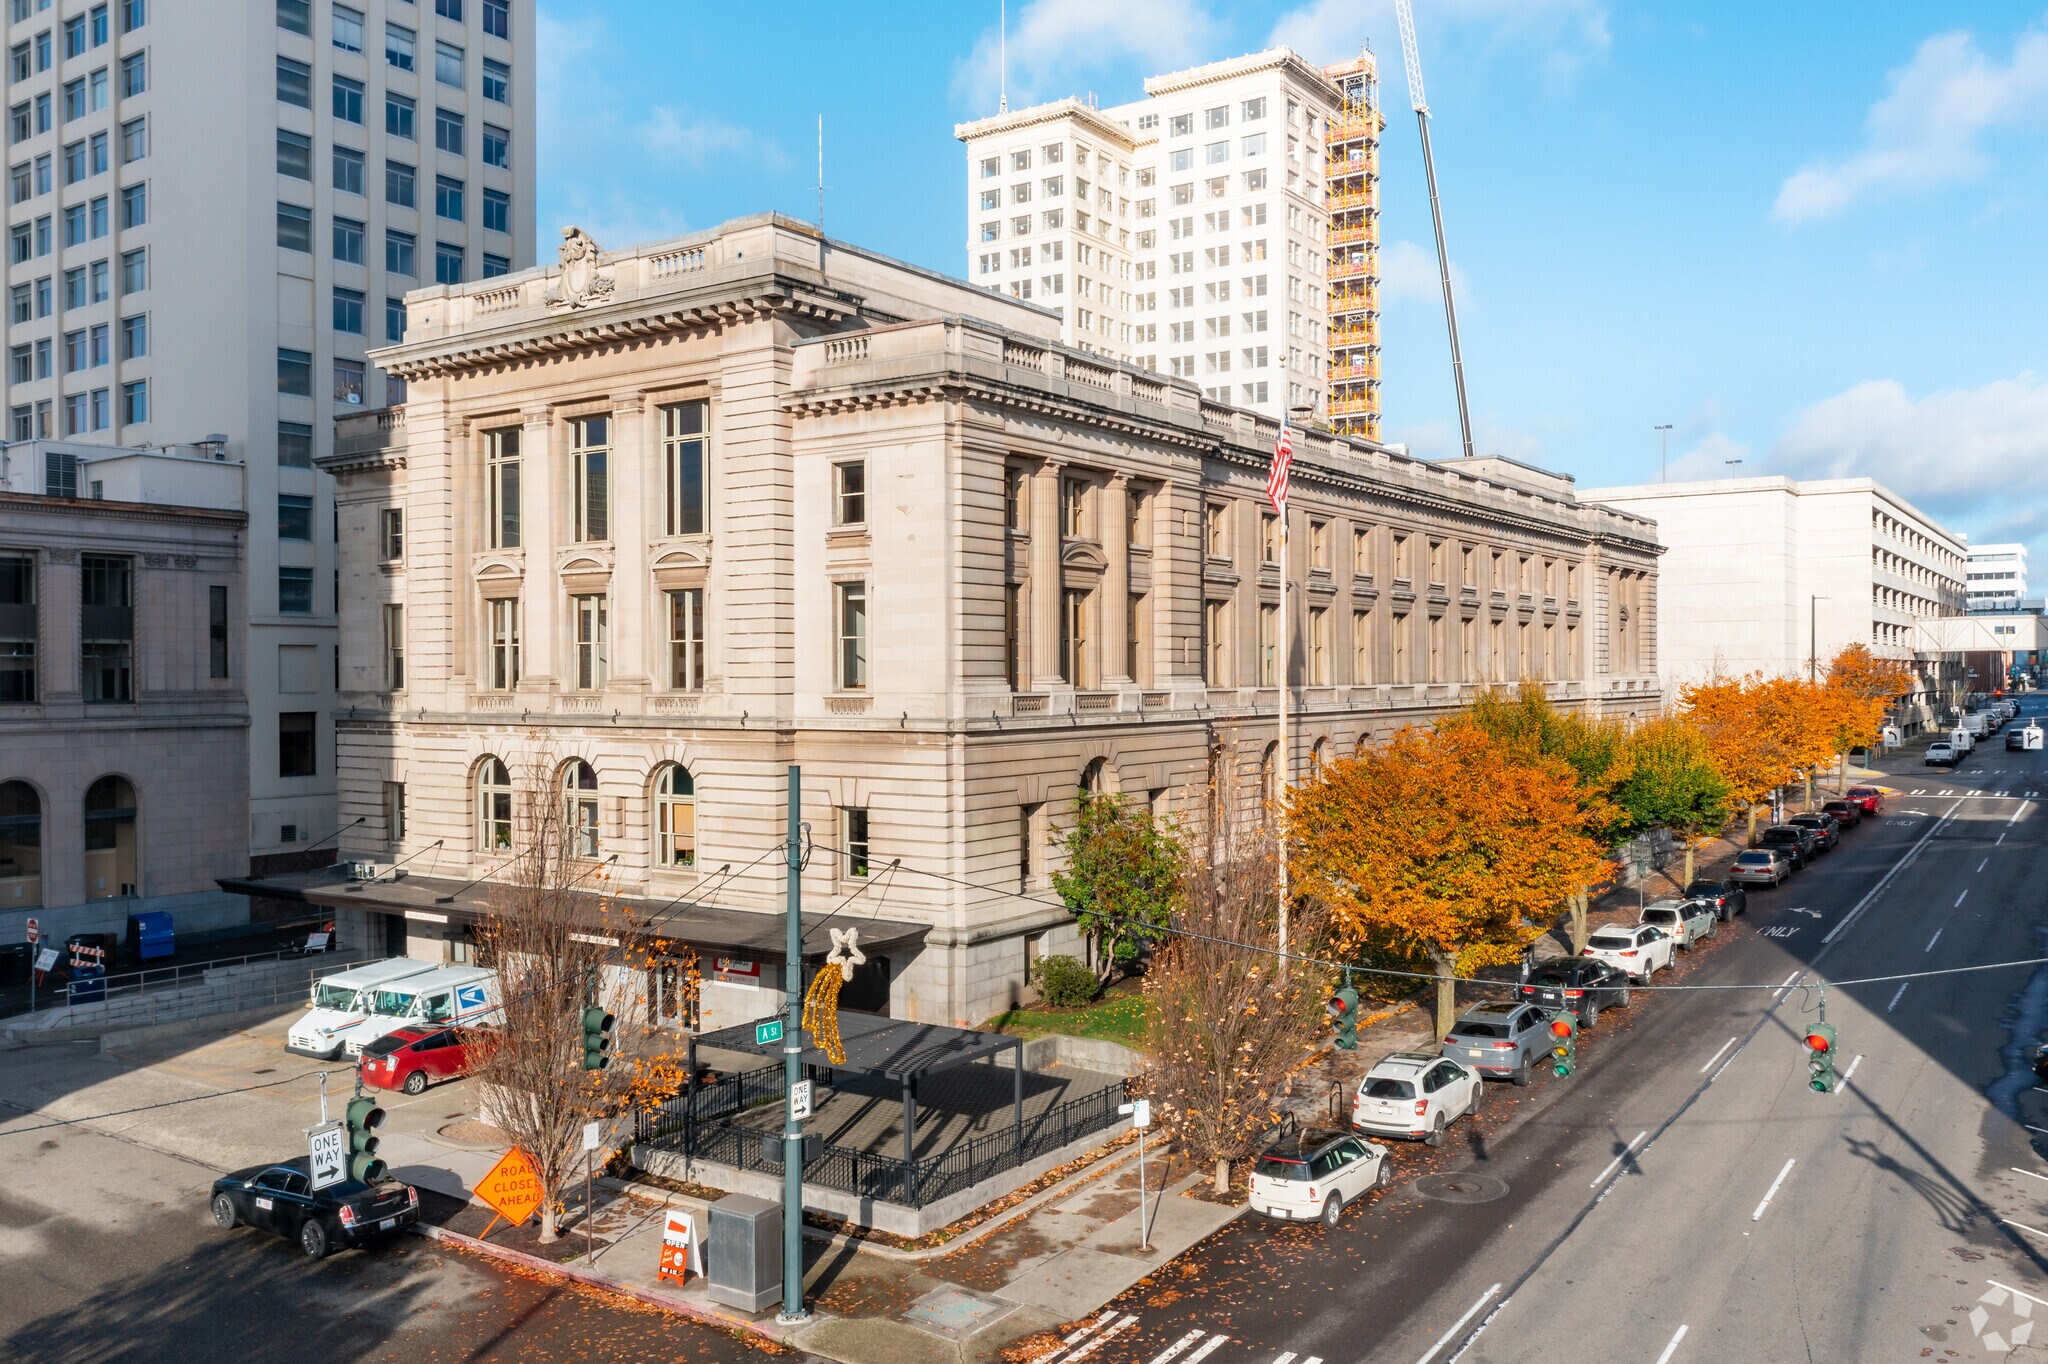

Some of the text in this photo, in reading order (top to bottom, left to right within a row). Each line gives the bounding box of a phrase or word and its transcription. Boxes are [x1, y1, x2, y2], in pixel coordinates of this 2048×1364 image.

[762, 1026, 778, 1040] A St
[793, 1084, 808, 1096] ONE
[793, 1094, 808, 1106] WAY
[314, 1133, 339, 1151] ONE
[314, 1148, 340, 1167] WAY
[498, 1192, 541, 1207] AHEAD
[666, 1239, 685, 1249] OPEN
